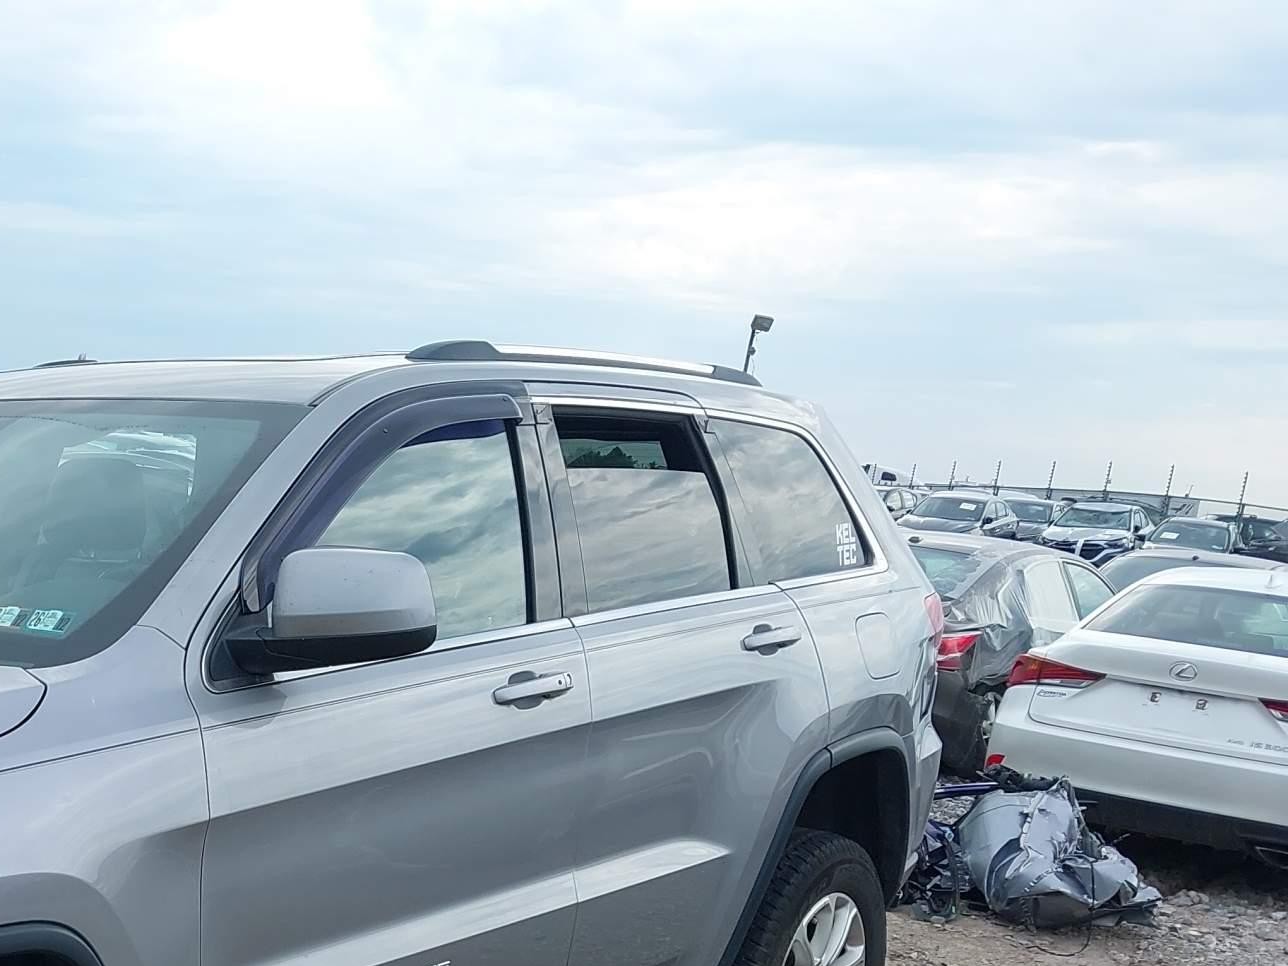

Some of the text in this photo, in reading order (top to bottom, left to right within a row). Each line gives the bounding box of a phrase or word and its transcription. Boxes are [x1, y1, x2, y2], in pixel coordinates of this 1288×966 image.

[835, 522, 856, 545] KEL
[836, 543, 857, 567] TEC
[28, 611, 46, 628] 26
